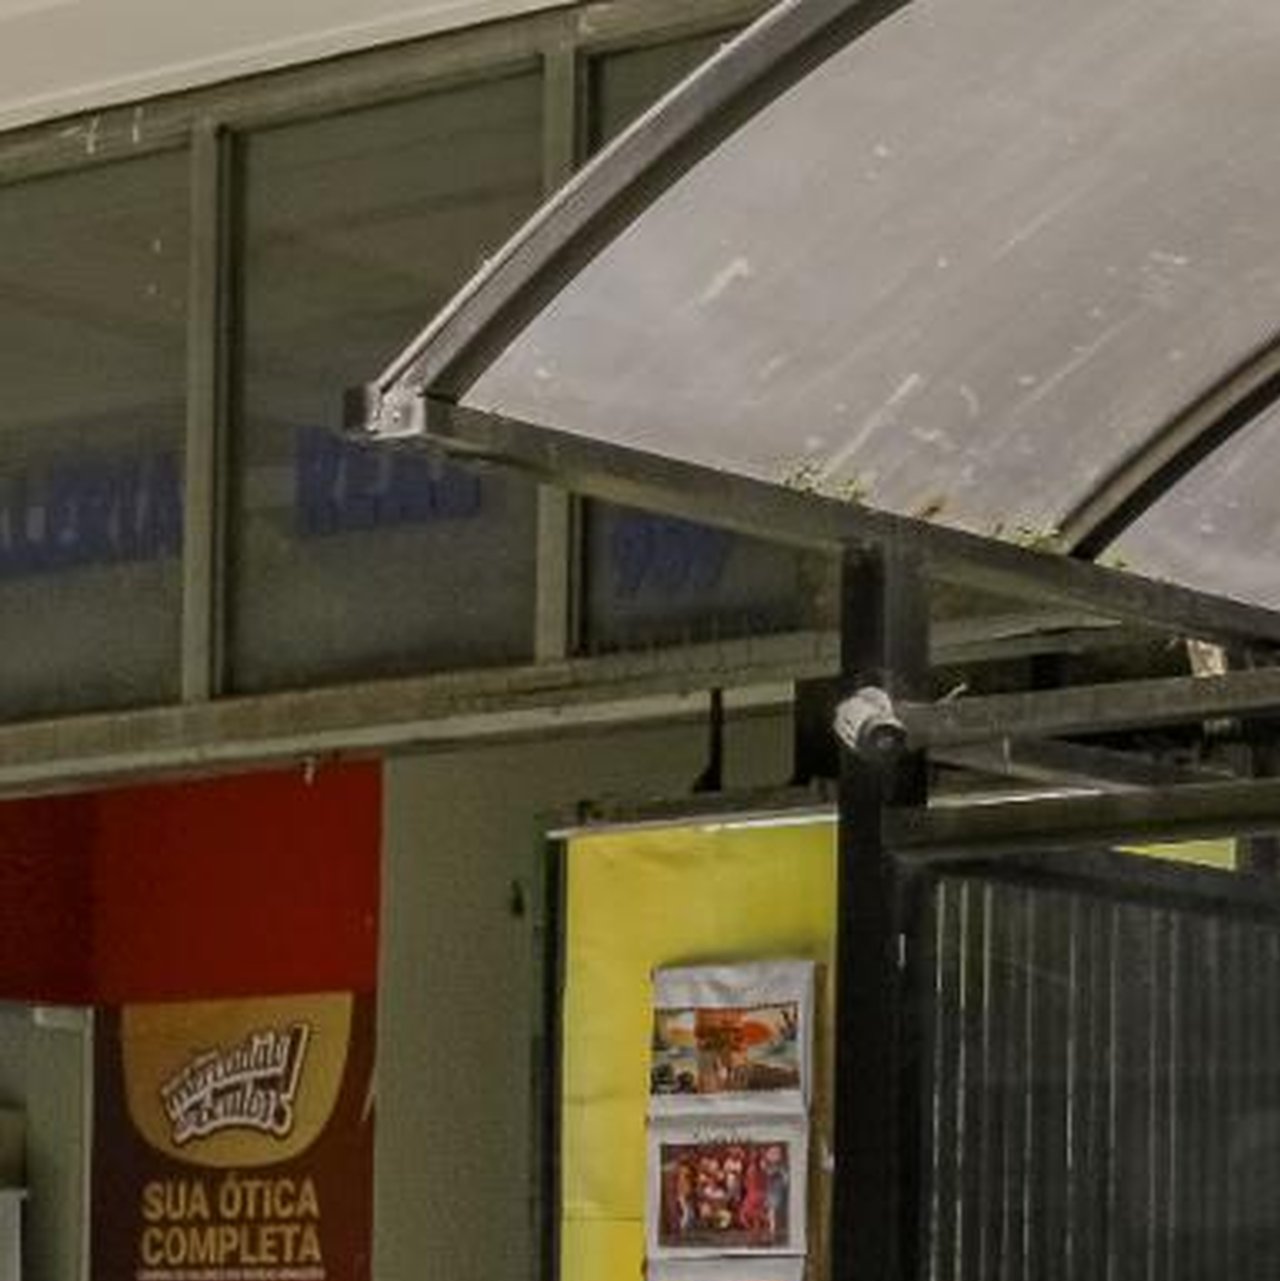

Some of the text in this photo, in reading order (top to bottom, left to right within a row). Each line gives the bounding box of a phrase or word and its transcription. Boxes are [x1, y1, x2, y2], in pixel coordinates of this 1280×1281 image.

[143, 1171, 320, 1221] SUA ÓTICA
[142, 1223, 322, 1264] COMPLETA
